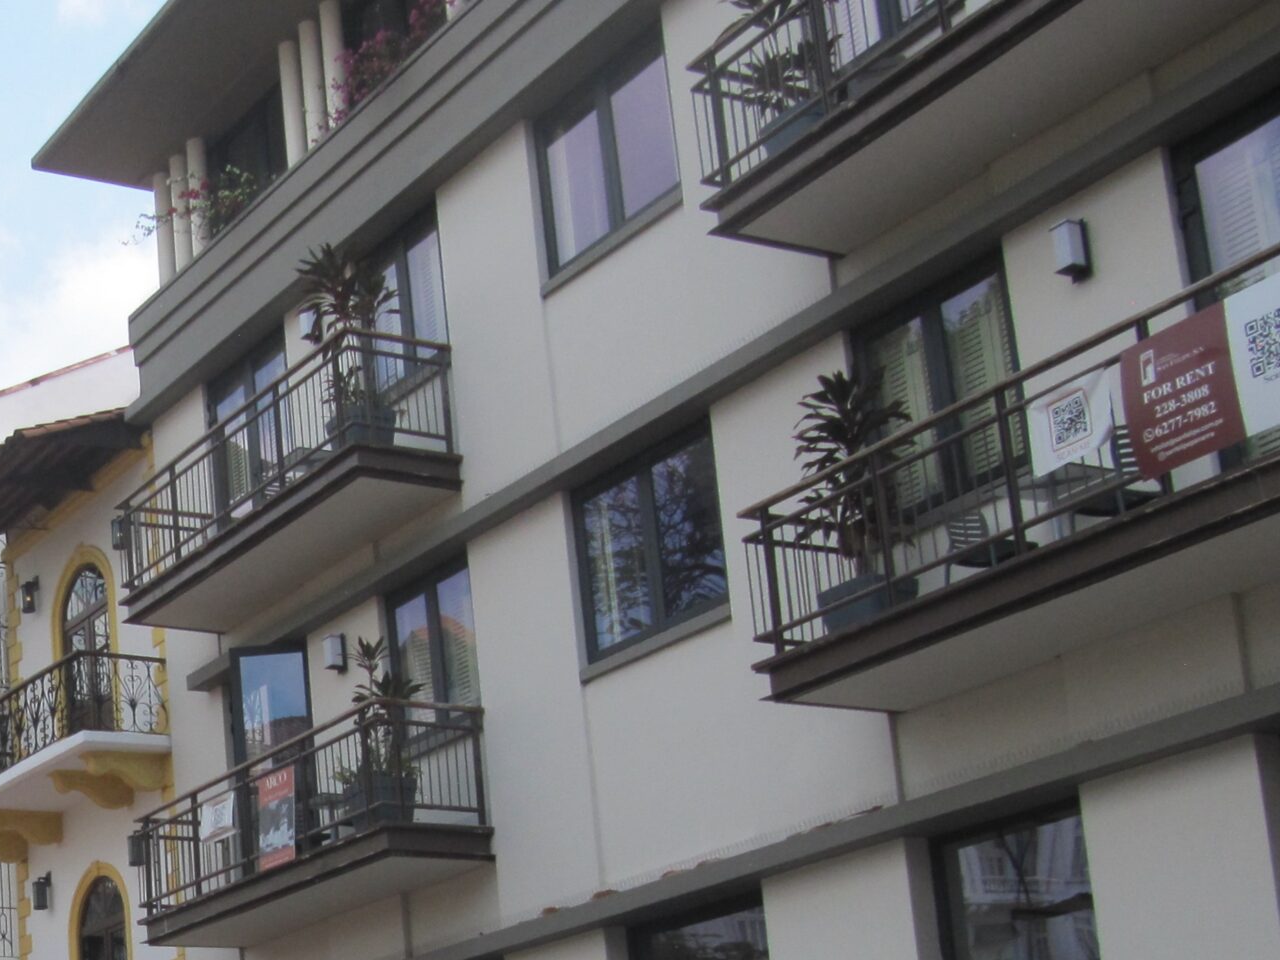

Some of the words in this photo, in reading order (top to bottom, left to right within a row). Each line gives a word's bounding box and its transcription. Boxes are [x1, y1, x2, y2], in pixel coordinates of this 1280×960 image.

[1143, 381, 1173, 404] FOR
[1175, 360, 1216, 389] RENT
[1154, 384, 1211, 418] 228-3808
[1154, 401, 1218, 437] 6277-7982
